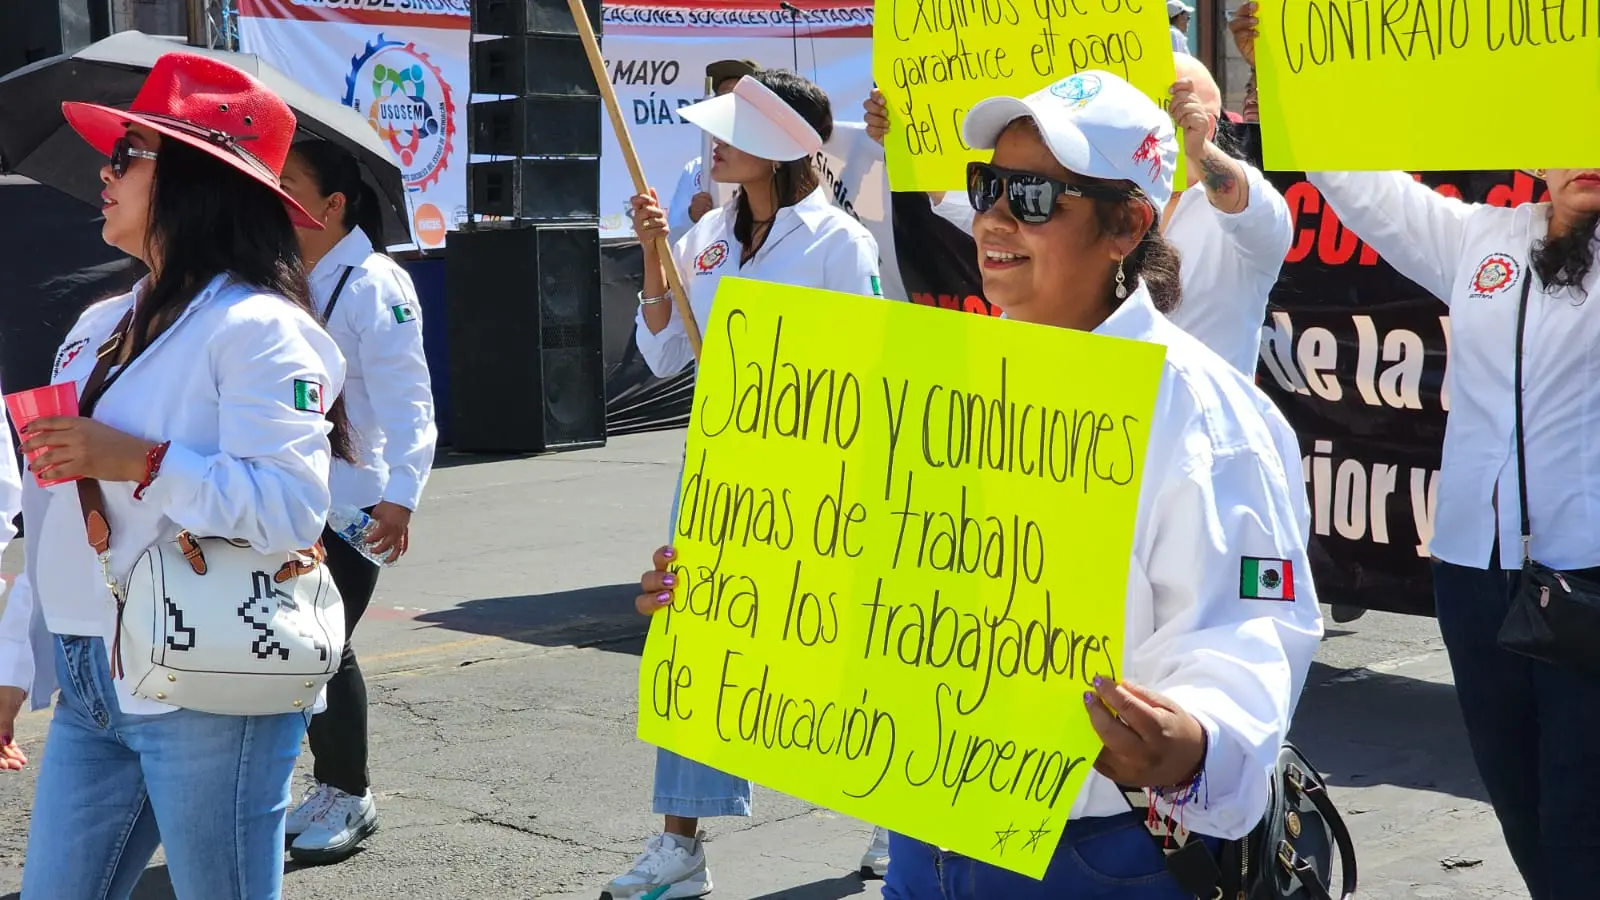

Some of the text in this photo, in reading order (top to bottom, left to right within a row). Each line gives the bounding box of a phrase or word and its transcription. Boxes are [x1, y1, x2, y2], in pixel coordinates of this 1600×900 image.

[688, 9, 768, 24] SOCIALES
[380, 103, 423, 121] USOSEM
[611, 60, 681, 86] MAYO
[632, 91, 675, 125] DÍA
[893, 39, 1013, 115] garantice
[1068, 30, 1143, 82] pago
[905, 102, 943, 155] del
[1259, 311, 1344, 402] de
[1352, 315, 1424, 410] la
[700, 308, 1139, 502] Salario y condiciones
[678, 448, 1044, 627] dignas de trabajo
[664, 563, 759, 639] para
[782, 559, 838, 647] los
[652, 634, 1087, 809] de Educación Superior
